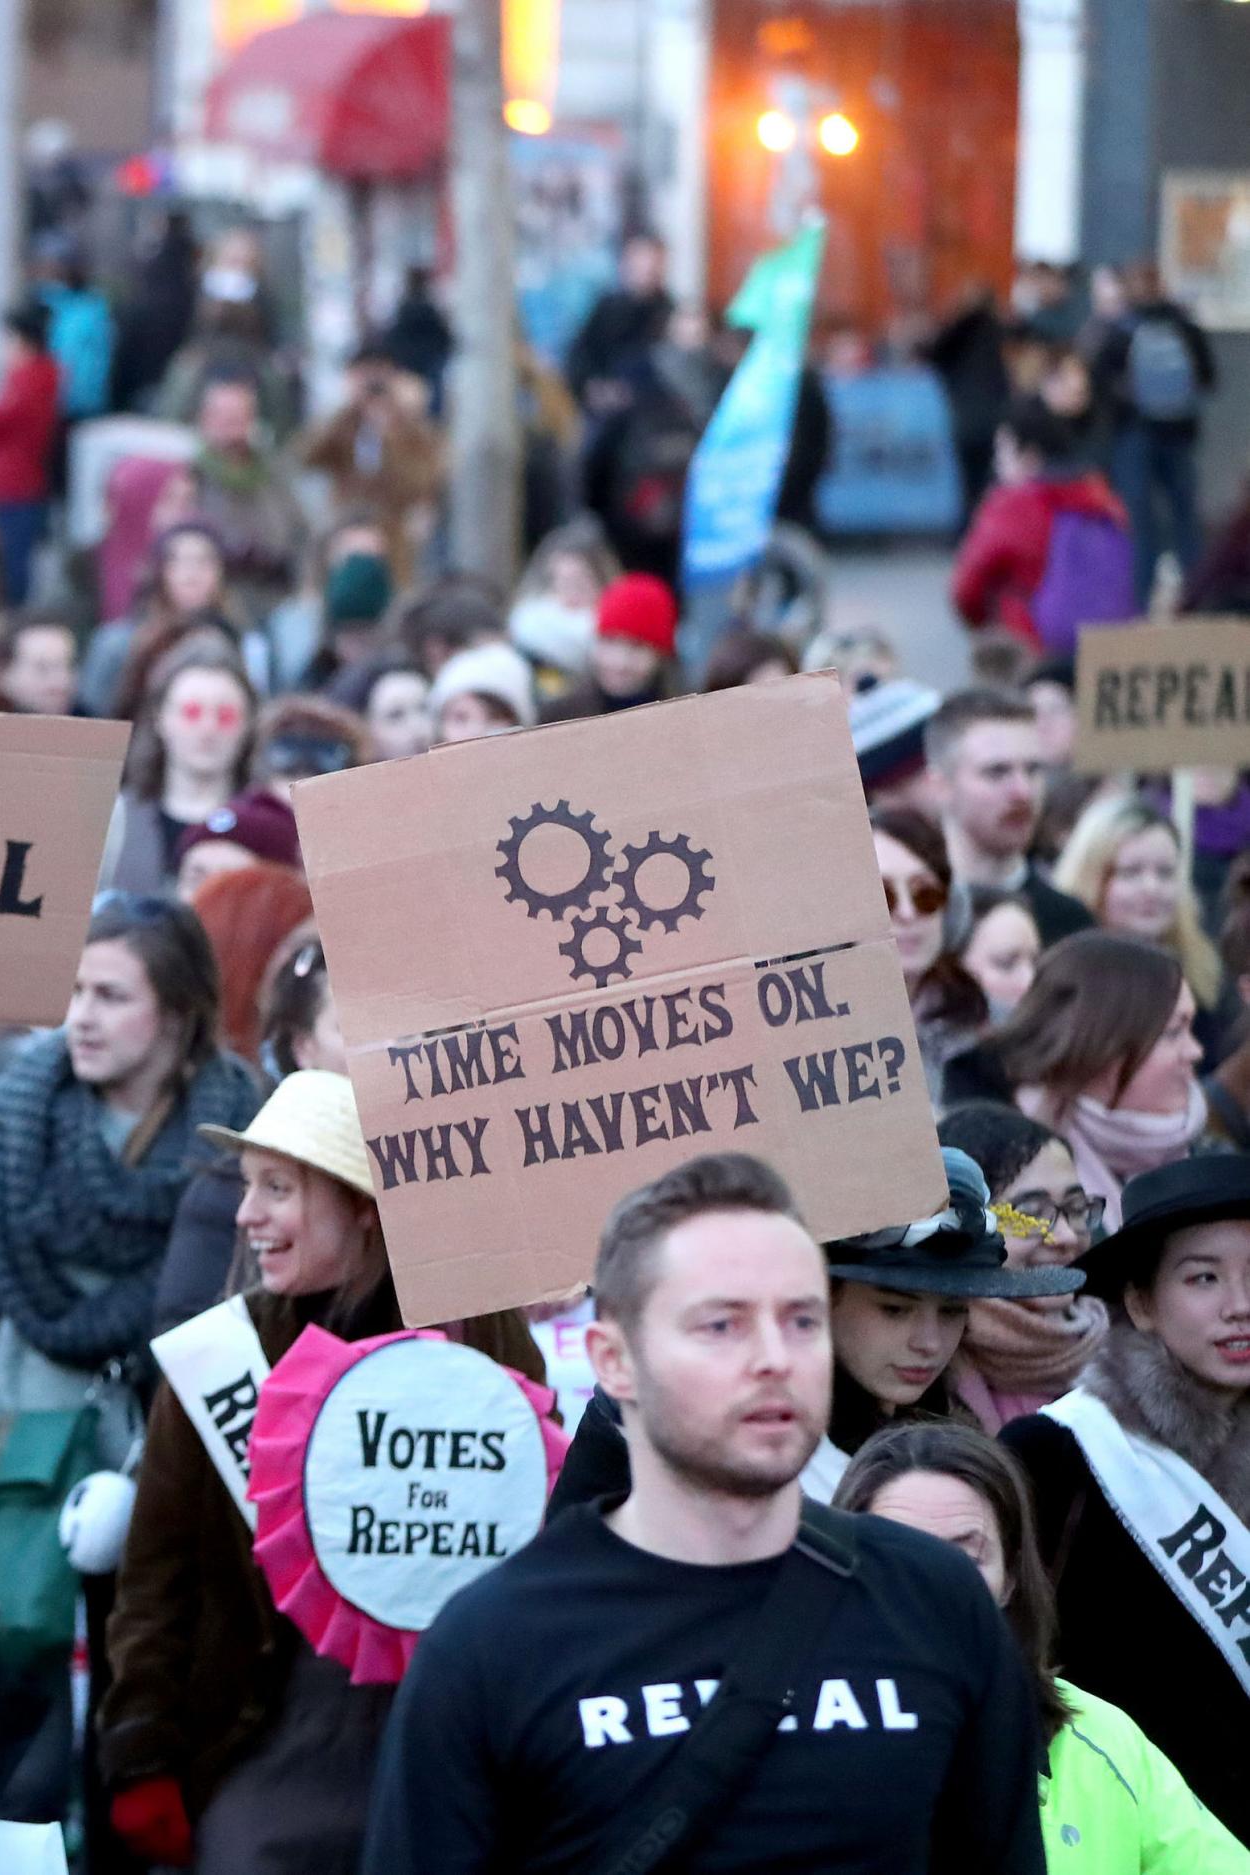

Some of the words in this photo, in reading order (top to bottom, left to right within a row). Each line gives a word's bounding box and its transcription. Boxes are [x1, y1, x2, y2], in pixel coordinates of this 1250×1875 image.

[1095, 663, 1250, 729] REPEA
[388, 1021, 526, 1105] TIME
[544, 984, 734, 1074] MOVES
[756, 961, 850, 1028] ON.
[367, 1116, 492, 1190] WHY
[514, 1064, 760, 1168] HAVEN'T
[784, 1036, 906, 1113] WE?
[356, 1409, 506, 1471] VOTES
[347, 1504, 508, 1558] REPEAL
[578, 1678, 918, 1749] REAL
